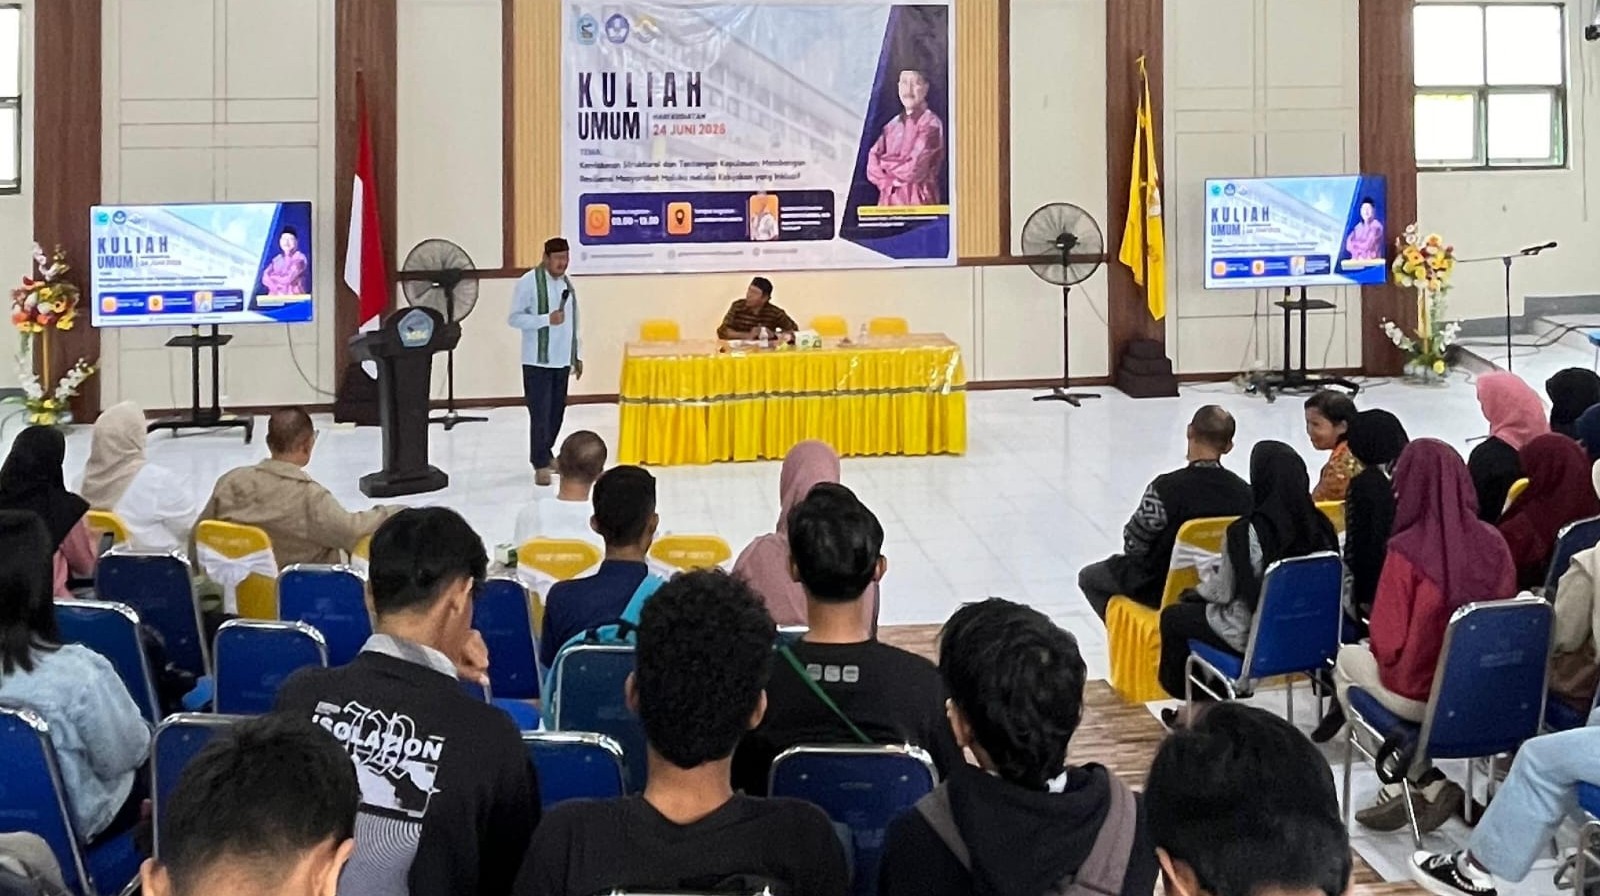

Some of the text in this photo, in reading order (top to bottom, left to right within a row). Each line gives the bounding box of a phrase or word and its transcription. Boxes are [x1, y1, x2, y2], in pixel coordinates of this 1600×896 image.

[578, 71, 702, 108] KULIAH
[578, 111, 640, 140] UMUM
[652, 124, 667, 137] 24
[670, 123, 696, 136] JUNI
[1211, 206, 1270, 223] KULIAH
[1211, 224, 1241, 236] UMUM
[97, 236, 169, 254] KULIAH
[97, 255, 134, 269] UMUM
